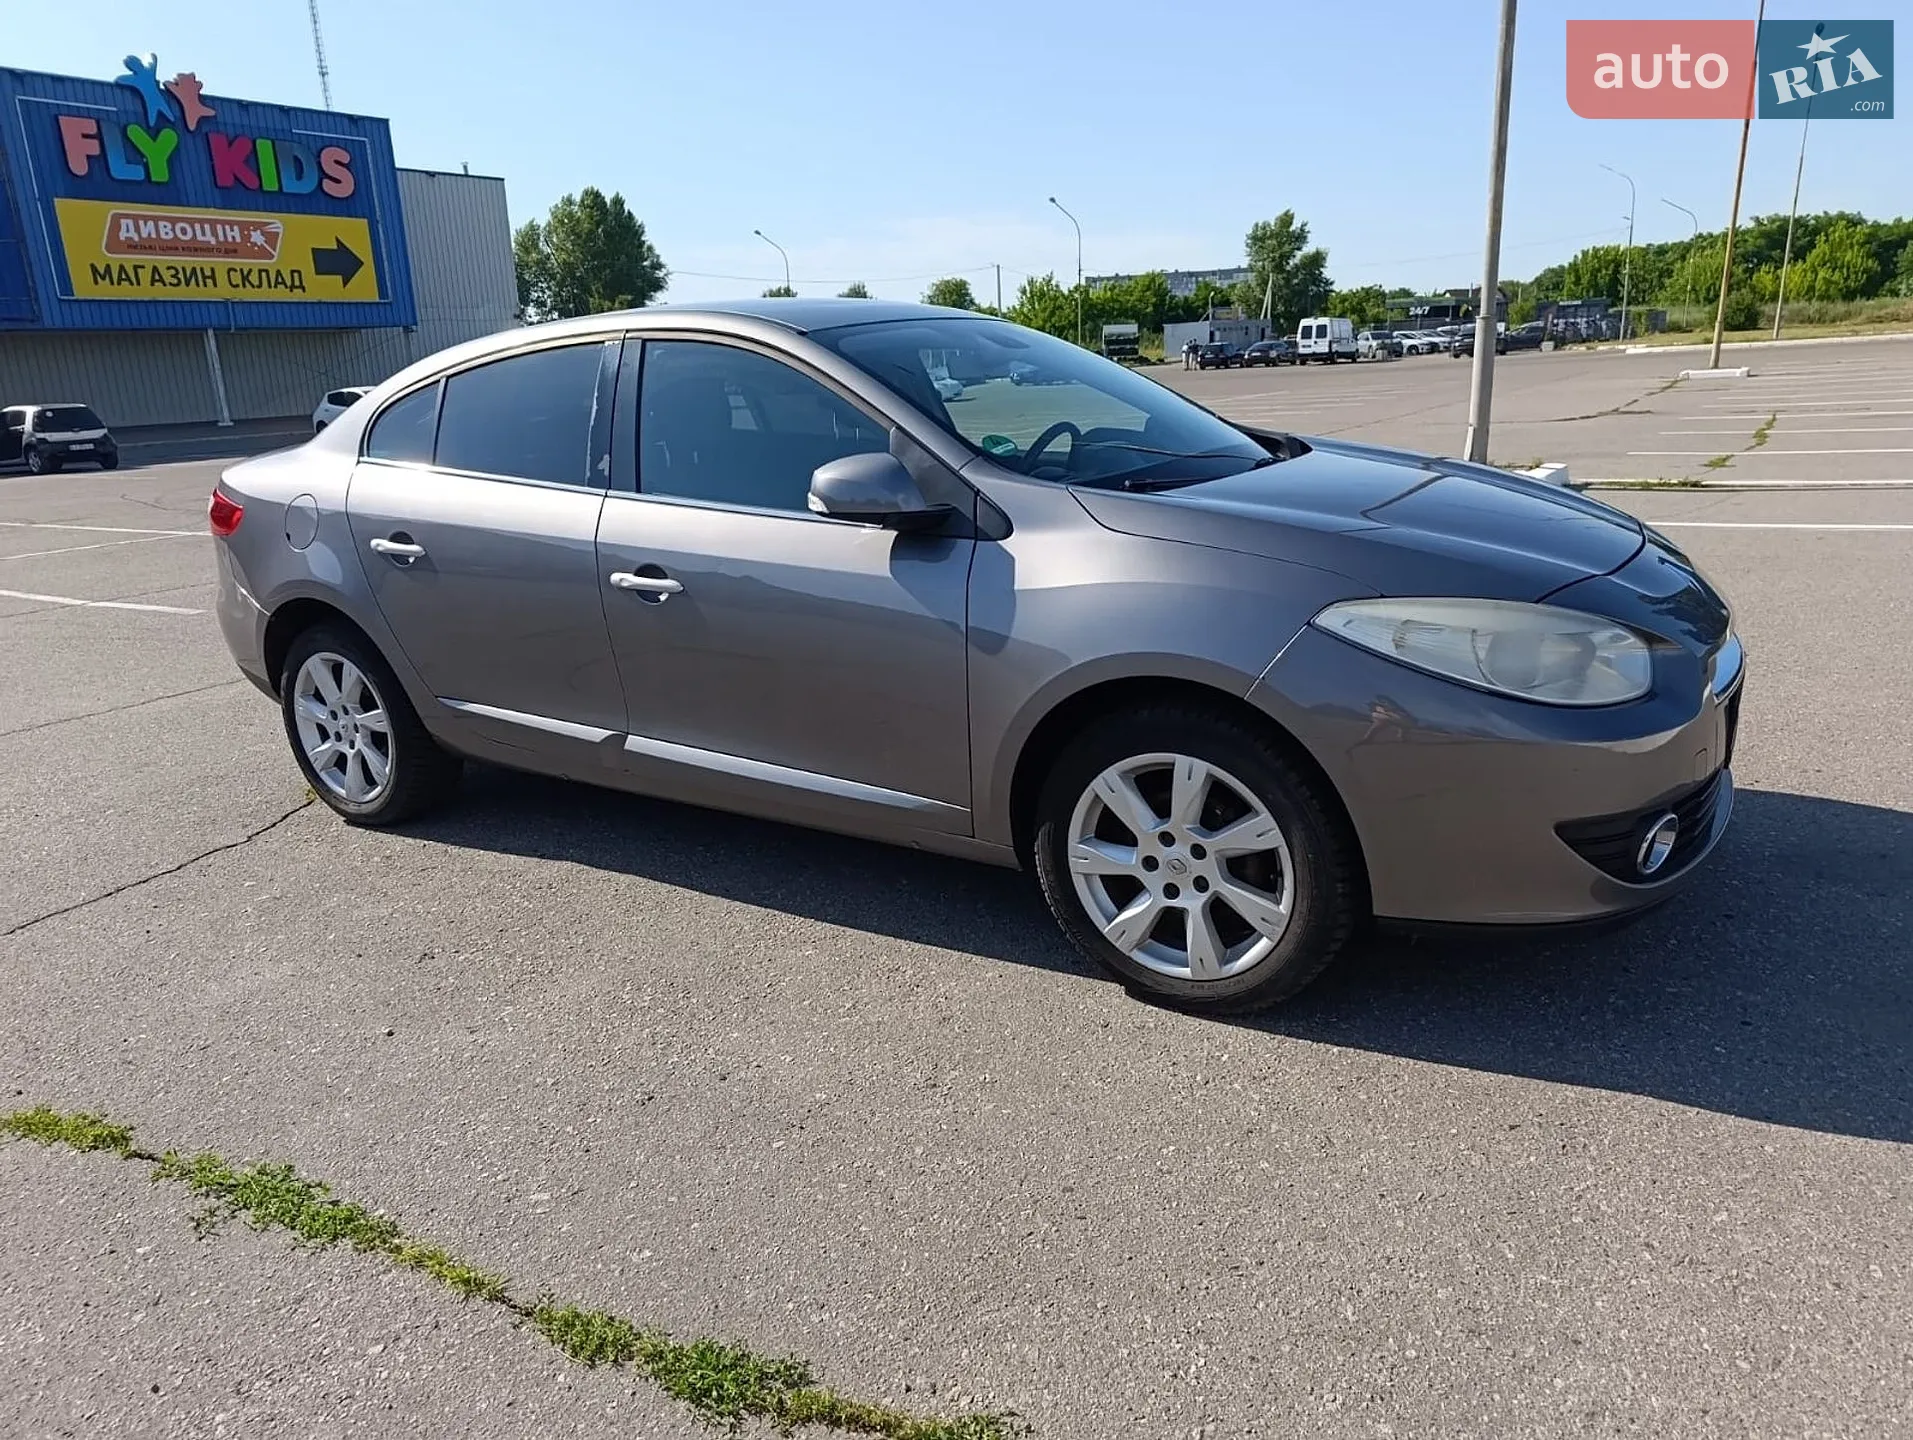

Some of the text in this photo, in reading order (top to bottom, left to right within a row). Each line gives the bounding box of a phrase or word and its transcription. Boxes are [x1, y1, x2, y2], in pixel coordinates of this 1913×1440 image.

[58, 115, 356, 199] FLY KIDS
[118, 218, 242, 245] ДИВОЦІН
[89, 263, 306, 293] МАГАЗИН СКЛАД
